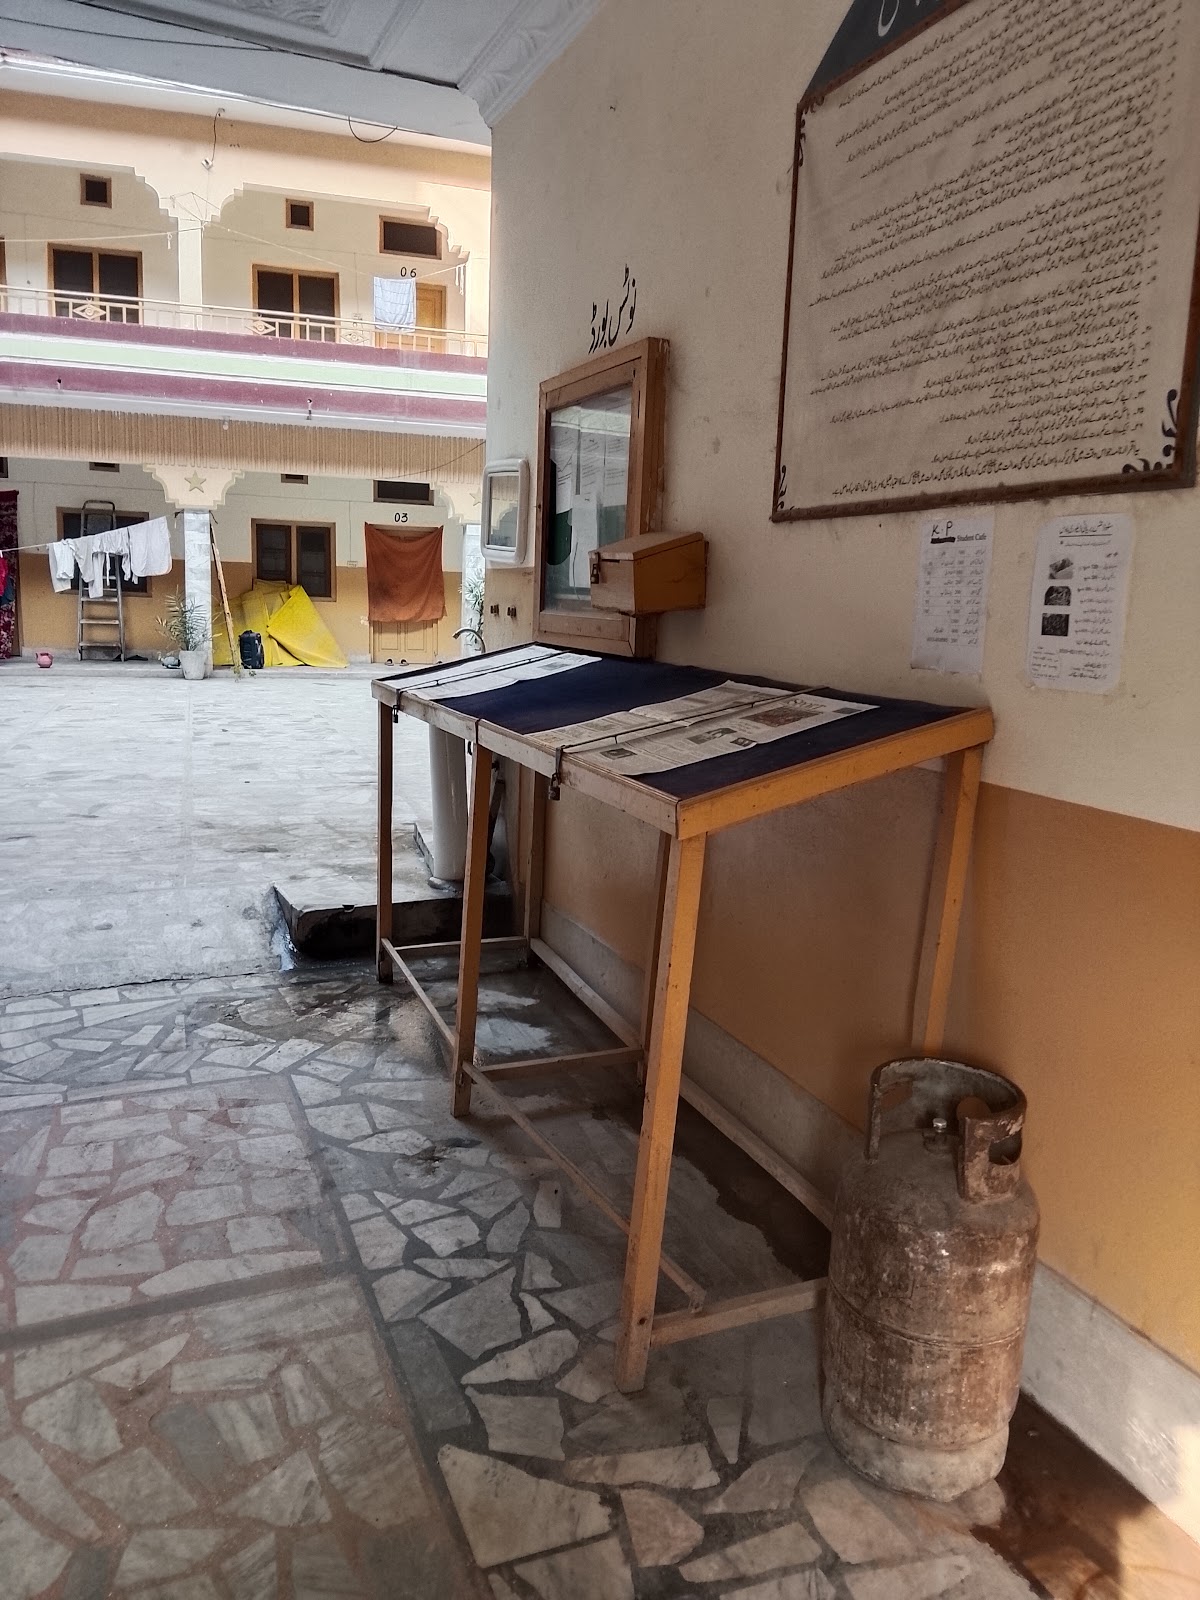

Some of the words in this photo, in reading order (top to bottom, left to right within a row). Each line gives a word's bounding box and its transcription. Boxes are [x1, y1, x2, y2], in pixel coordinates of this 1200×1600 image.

[400, 267, 417, 278] 06
[608, 264, 637, 347] نوٹس
[588, 299, 609, 354] بورڈ
[394, 512, 409, 523] 03
